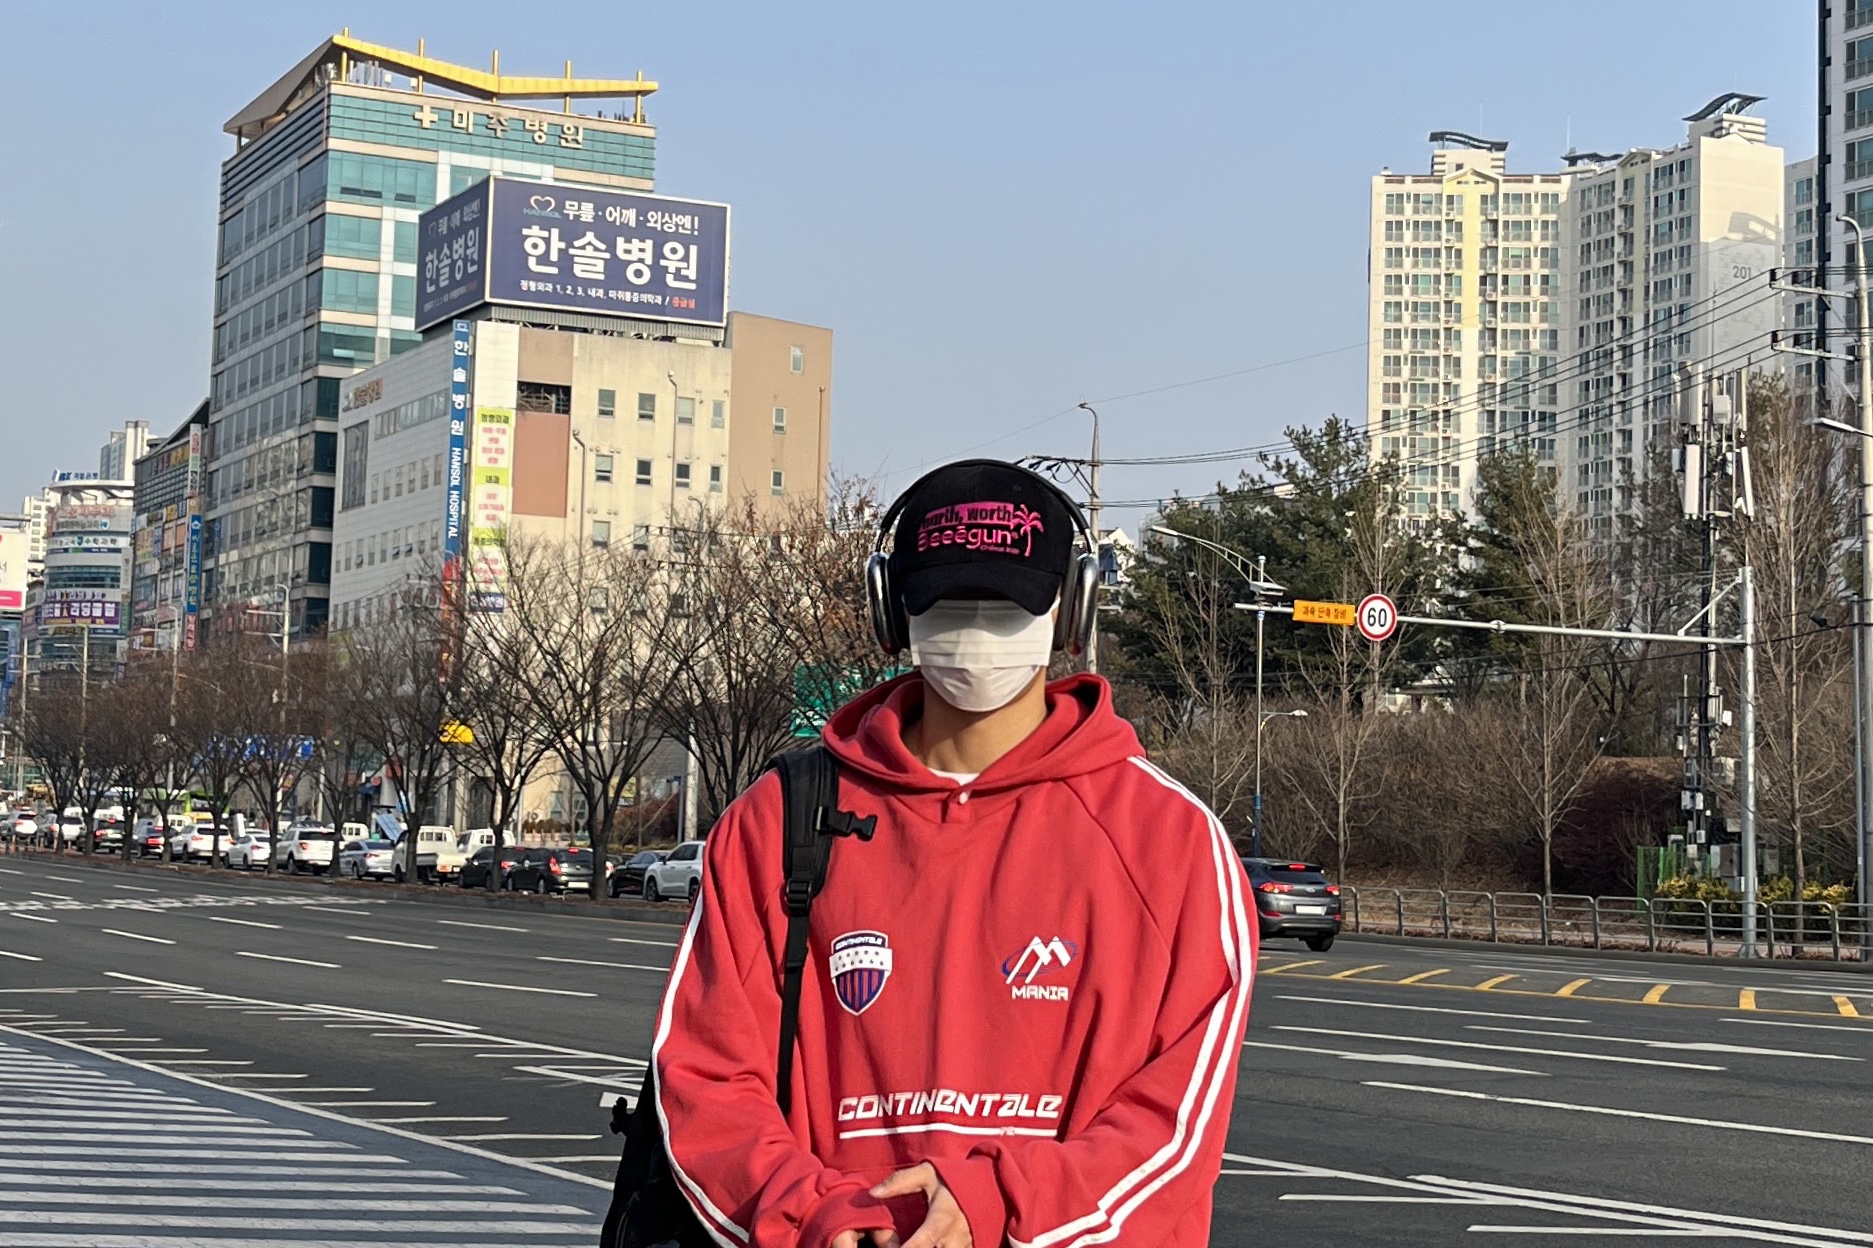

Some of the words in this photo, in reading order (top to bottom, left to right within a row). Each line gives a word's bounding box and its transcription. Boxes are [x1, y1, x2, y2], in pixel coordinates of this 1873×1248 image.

[563, 200, 595, 223] 무릎
[605, 206, 636, 228] 어깨
[425, 226, 480, 293] 한솔병원
[522, 225, 698, 290] 한솔병원
[451, 340, 469, 436] 한솔병원
[449, 447, 462, 487] HANSOL
[448, 489, 461, 538] HOSPITAL
[967, 505, 1011, 523] worth
[1367, 607, 1387, 628] 60
[1011, 985, 1069, 1001] MANIA
